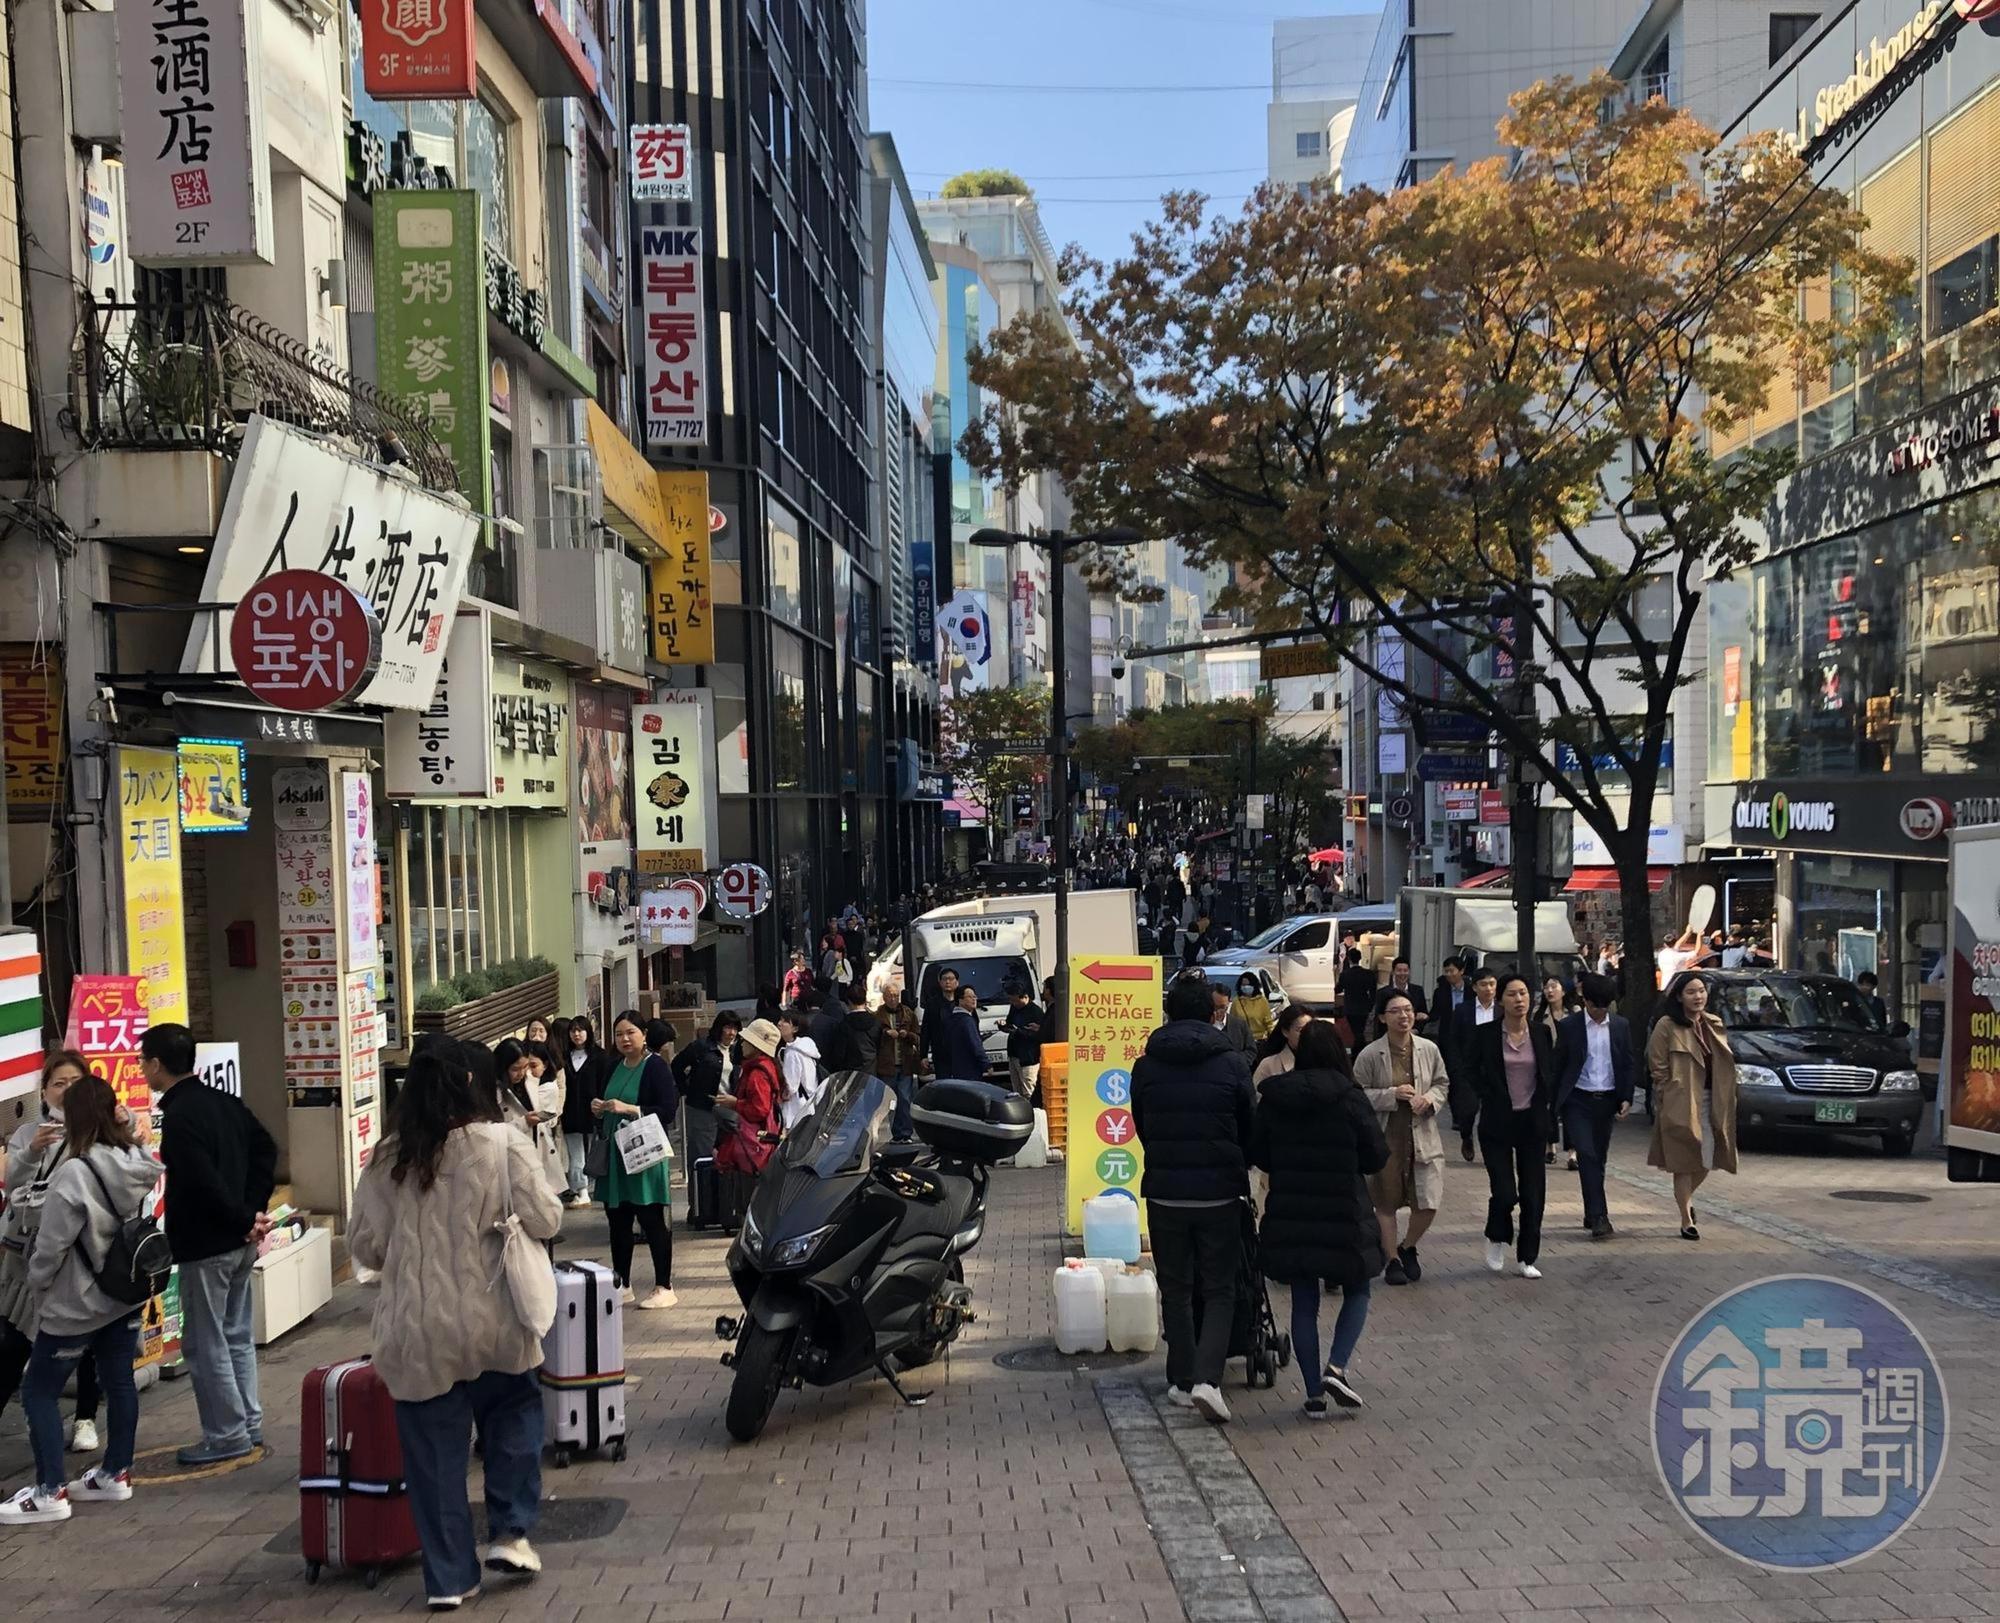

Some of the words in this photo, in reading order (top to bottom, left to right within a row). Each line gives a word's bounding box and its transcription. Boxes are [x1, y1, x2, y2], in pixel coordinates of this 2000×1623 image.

[379, 53, 400, 77] 3F
[1815, 1, 1941, 137] Steakhouse
[635, 129, 686, 180] 药
[174, 170, 203, 192] 인생
[636, 183, 688, 196] 새원약국
[177, 188, 210, 209] 포차
[175, 222, 210, 244] 2F
[643, 230, 698, 256] MK
[646, 261, 700, 414] 부동산
[648, 420, 704, 439] 777-7727
[1897, 411, 1991, 471] TWOSOME
[677, 541, 706, 629] 돈까스
[252, 589, 343, 641] 인생
[917, 579, 931, 643] 우리은행
[658, 592, 681, 658] 모밀
[252, 642, 354, 692] 포차
[123, 765, 175, 806] カバン
[278, 785, 325, 805] Asahi
[1736, 800, 1771, 829] OLIVE
[1788, 801, 1835, 832] YOUNG
[130, 818, 173, 863] 天国
[644, 858, 697, 871] 777-3231
[723, 868, 760, 913] 약
[82, 990, 124, 1017] ベラ
[1074, 993, 1134, 1006] MONEY
[1074, 1007, 1153, 1020] EXCHAGE
[1075, 1026, 1150, 1041] りょうがえ
[1074, 1044, 1107, 1062] 両替
[123, 1063, 144, 1080] OPE
[1106, 1073, 1128, 1105] $
[1818, 1108, 1855, 1121] 4516
[1105, 1115, 1128, 1143] ¥
[1103, 1153, 1130, 1180] 元
